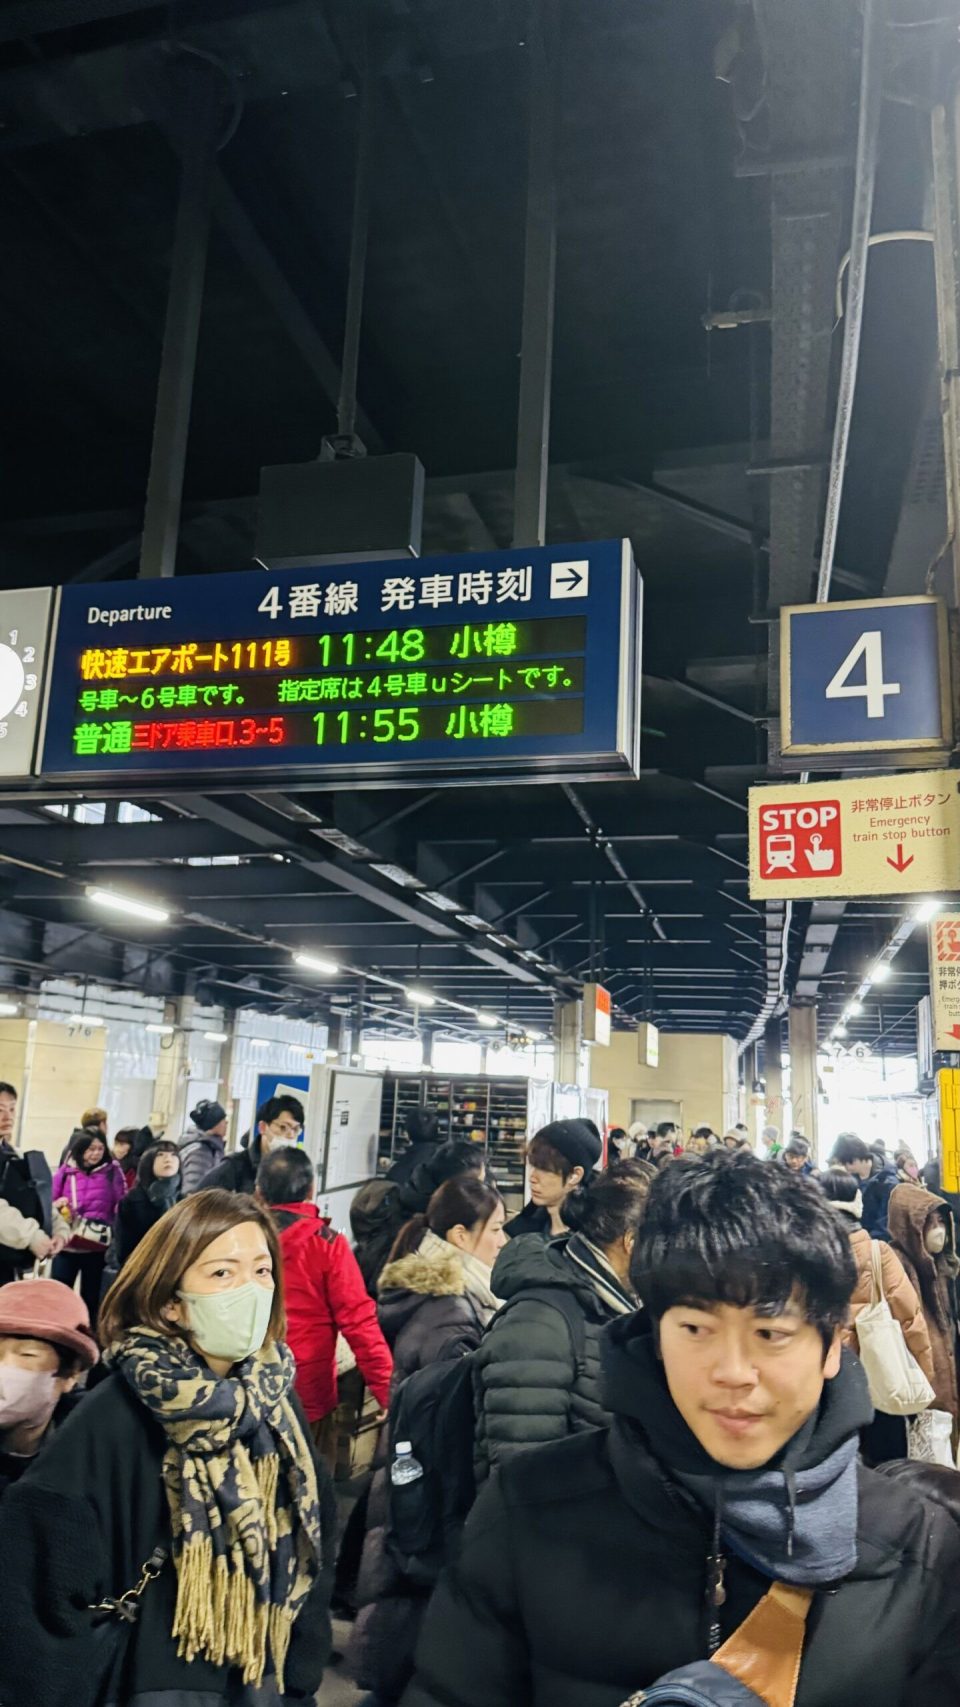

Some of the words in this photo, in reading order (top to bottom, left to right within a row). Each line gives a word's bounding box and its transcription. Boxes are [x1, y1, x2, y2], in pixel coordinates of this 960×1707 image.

[258, 581, 358, 619] 4番線
[380, 566, 533, 612] 発車時刻
[88, 605, 172, 627] Departure
[9, 629, 18, 645] 1
[318, 629, 425, 667] 11:48
[449, 622, 517, 658] 小樽
[22, 646, 36, 663] 2
[24, 673, 37, 691] 3
[826, 631, 900, 718] 4
[14, 701, 28, 718] 4
[313, 708, 420, 745] 11:55
[445, 704, 513, 740] 小樽
[851, 793, 951, 813] 非常停止ボタン
[762, 806, 837, 831] STOP
[869, 815, 931, 828] Emergency
[853, 832, 878, 842] train
[882, 830, 907, 841] stop
[911, 827, 951, 838] button
[855, 1047, 865, 1058] 6
